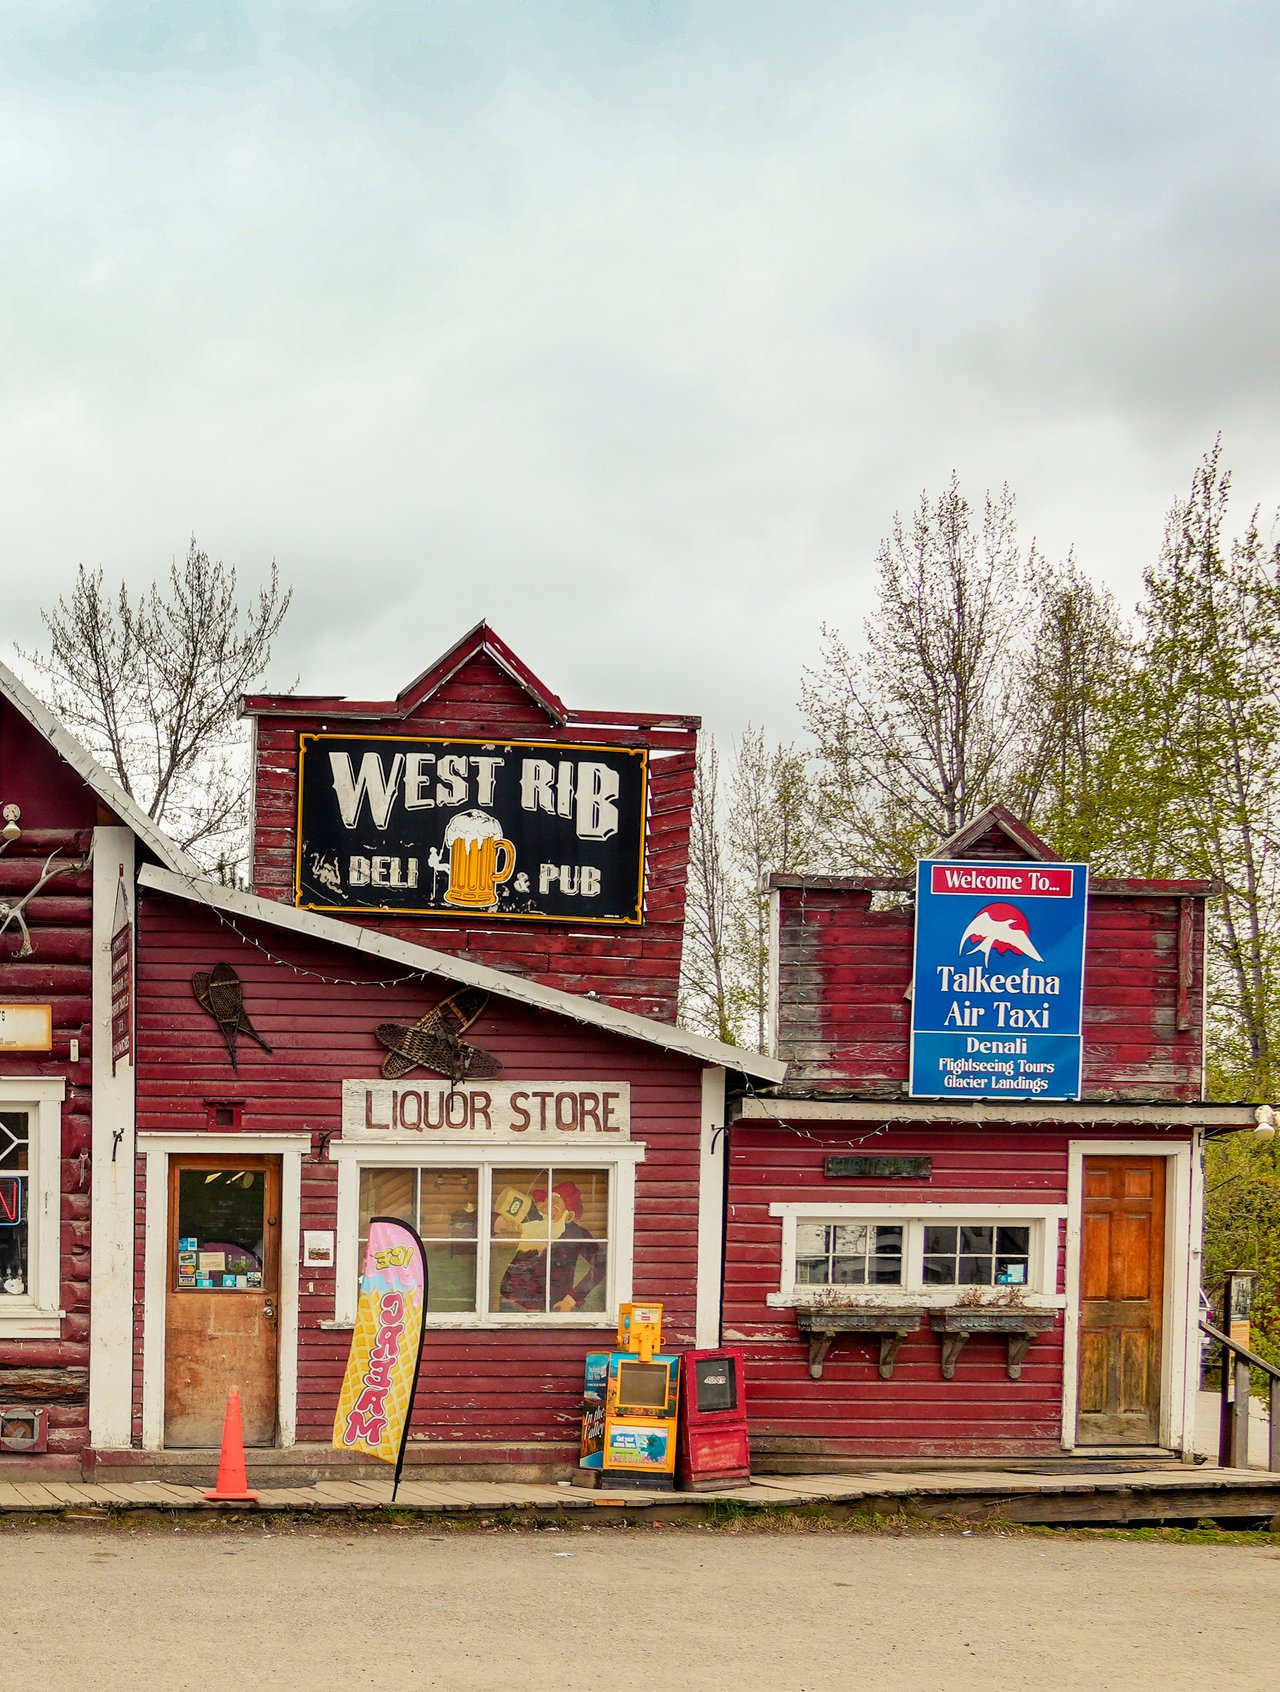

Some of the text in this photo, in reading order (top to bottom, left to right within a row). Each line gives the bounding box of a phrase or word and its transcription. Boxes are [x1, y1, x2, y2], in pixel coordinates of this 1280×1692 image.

[328, 751, 621, 841] WEST RIB
[349, 855, 602, 897] DELI & PUB
[945, 870, 1060, 891] Welcome To...
[936, 966, 1060, 995] Talkeetna
[943, 1000, 1050, 1028] Air Taxi
[966, 1037, 1028, 1054] Denali
[938, 1057, 1055, 1076] Flightseeing Tours
[944, 1074, 1048, 1093] Glacier Landings
[365, 1090, 620, 1132] LIQUOR STORE
